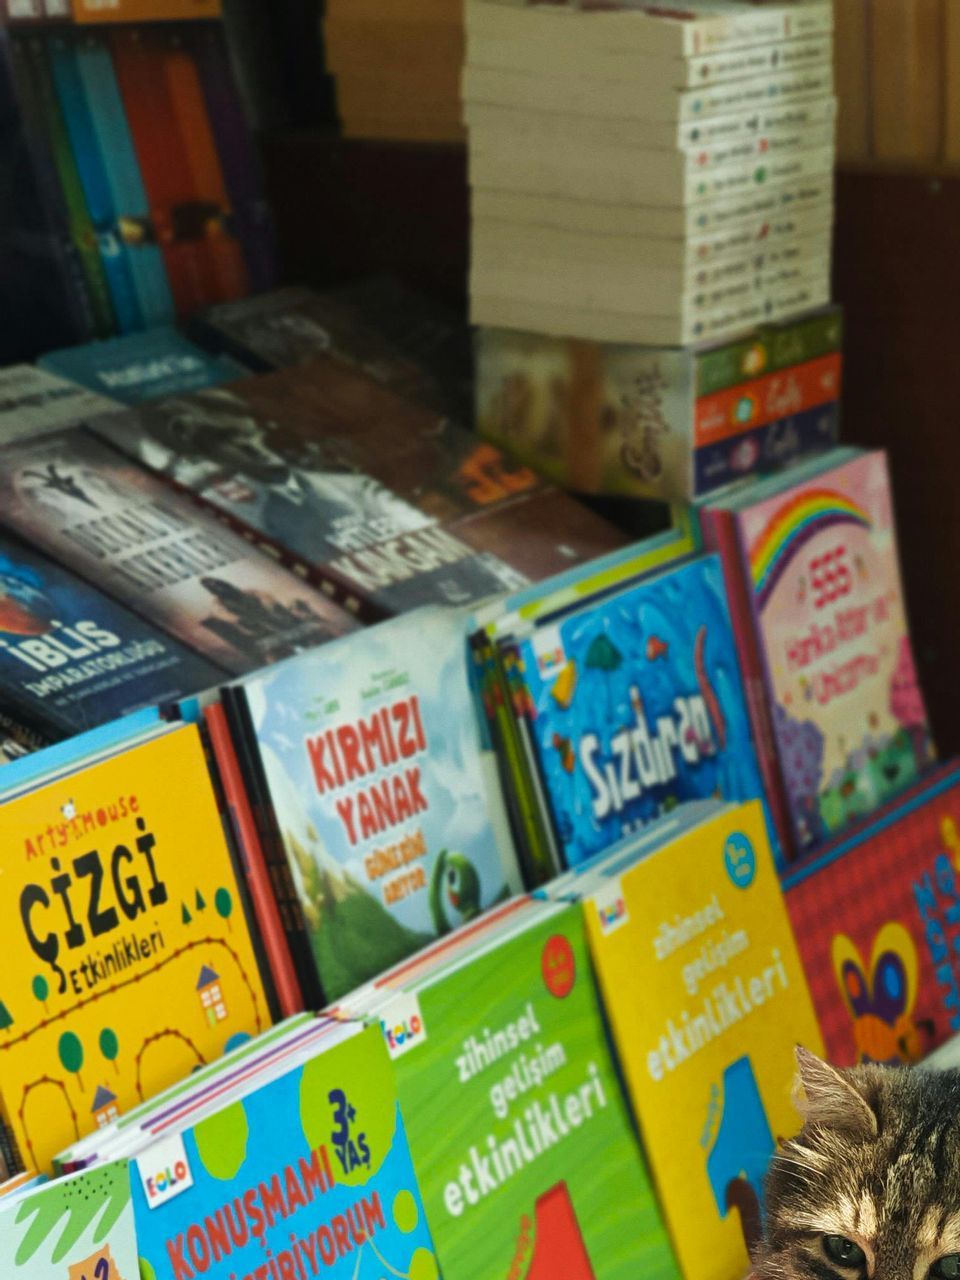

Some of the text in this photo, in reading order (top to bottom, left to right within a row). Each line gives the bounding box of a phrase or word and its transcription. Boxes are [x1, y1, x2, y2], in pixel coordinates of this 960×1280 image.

[0, 619, 121, 672] İBLİS
[306, 695, 426, 795] KIRMIZI
[336, 767, 428, 845] YANAK
[20, 817, 167, 994] ÇİZGİ
[653, 894, 724, 961] zihinsel
[683, 929, 748, 995] gelişim
[386, 1016, 421, 1049] EOLO
[455, 1002, 540, 1083] zihinsel
[647, 948, 788, 1081] etkinlikleri
[490, 1042, 566, 1118] gelişim
[328, 1088, 356, 1146] 3+
[444, 1061, 606, 1216] etkinlikleri
[146, 1161, 186, 1198] EOLO
[335, 1132, 371, 1175] YAŞ
